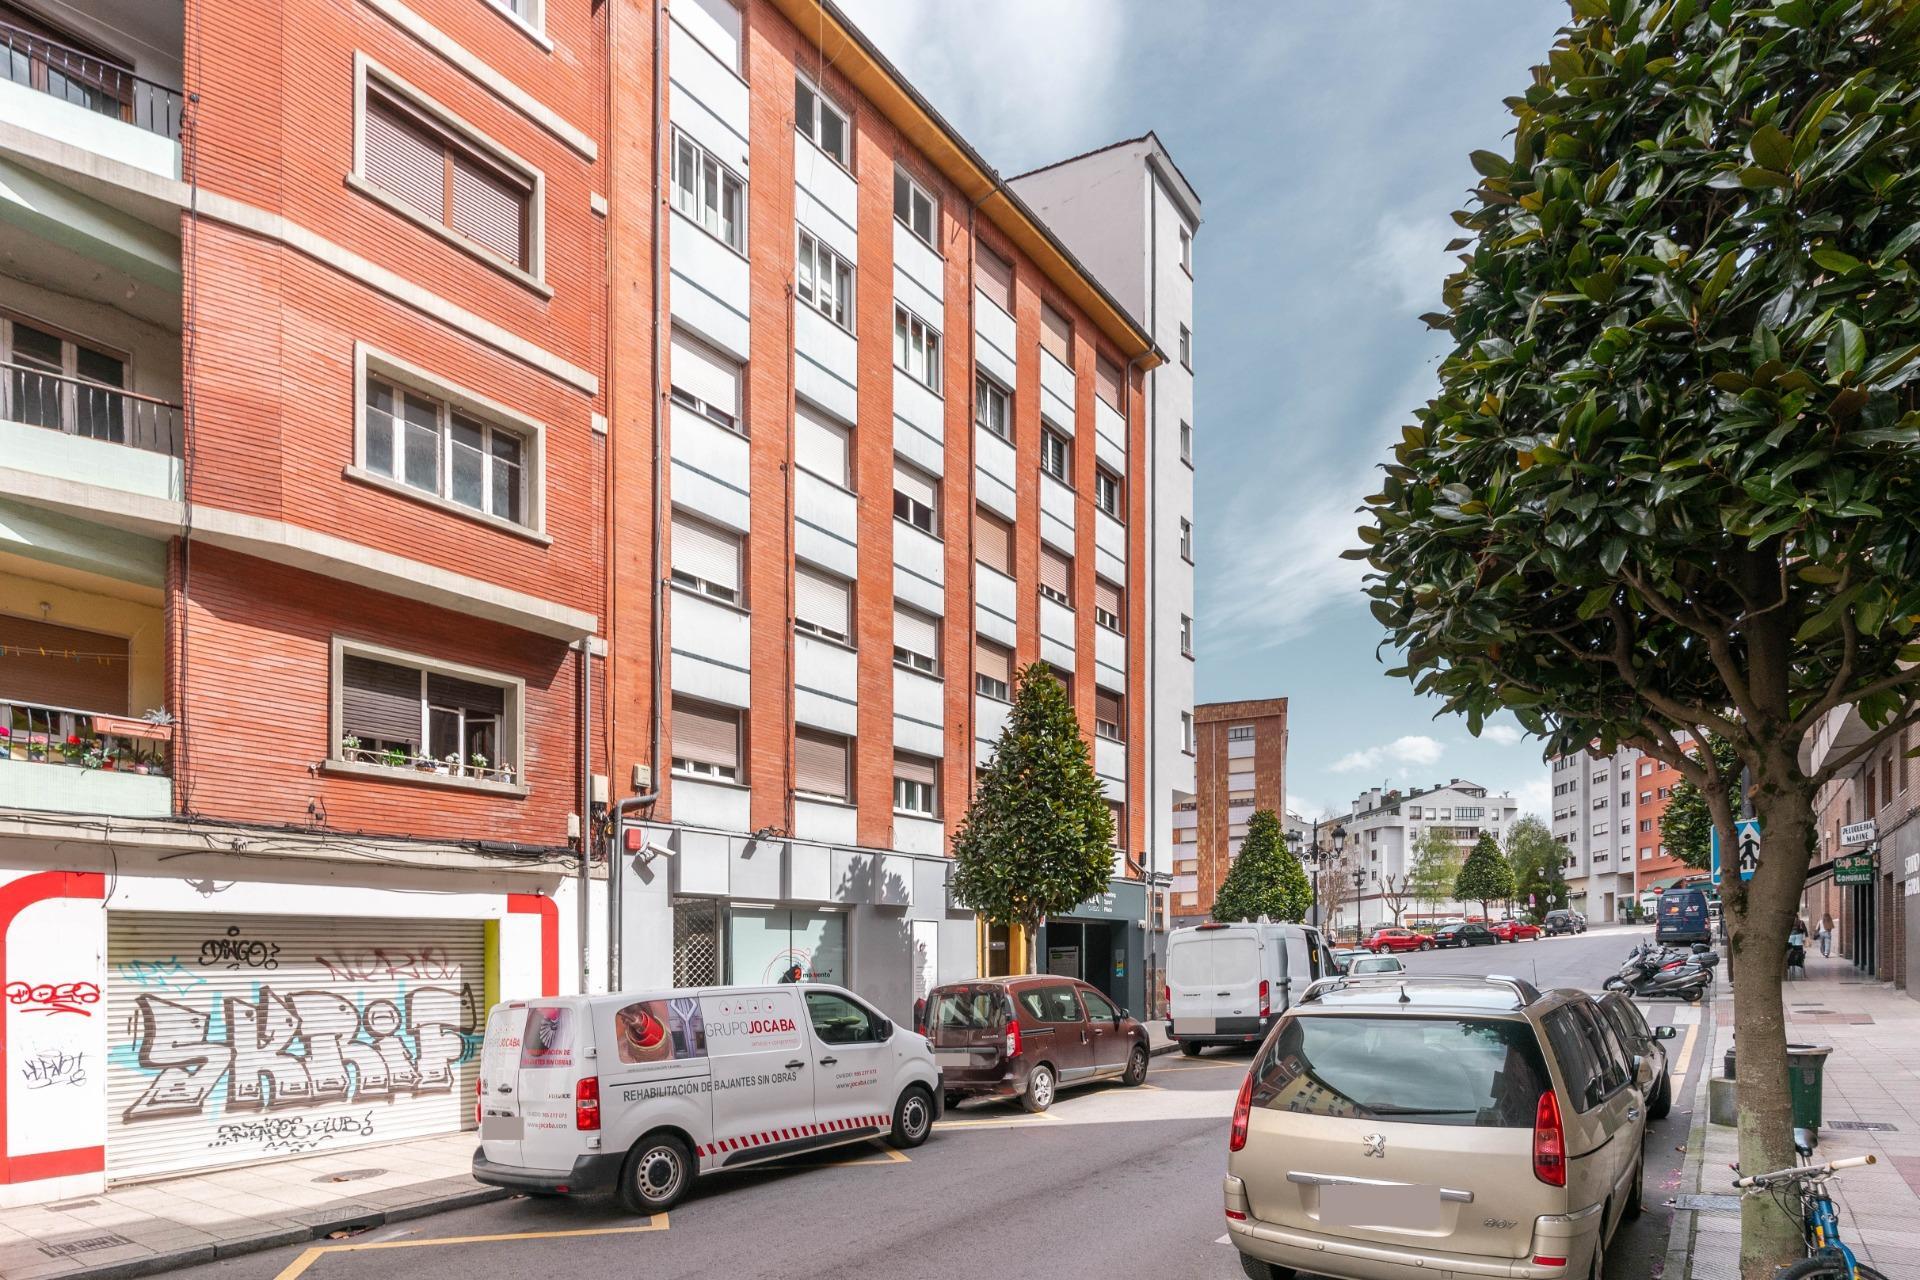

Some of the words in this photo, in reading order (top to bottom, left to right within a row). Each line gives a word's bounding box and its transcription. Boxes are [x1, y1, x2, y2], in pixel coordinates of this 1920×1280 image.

[1855, 857, 1869, 866] Bar
[623, 1080, 699, 1102] REHABILITACIÓN
[701, 1081, 712, 1093] DE
[714, 1076, 756, 1091] BAJANTES
[757, 1074, 770, 1085] SIN
[771, 1071, 797, 1083] OBRAS
[1483, 1217, 1518, 1230] 807
